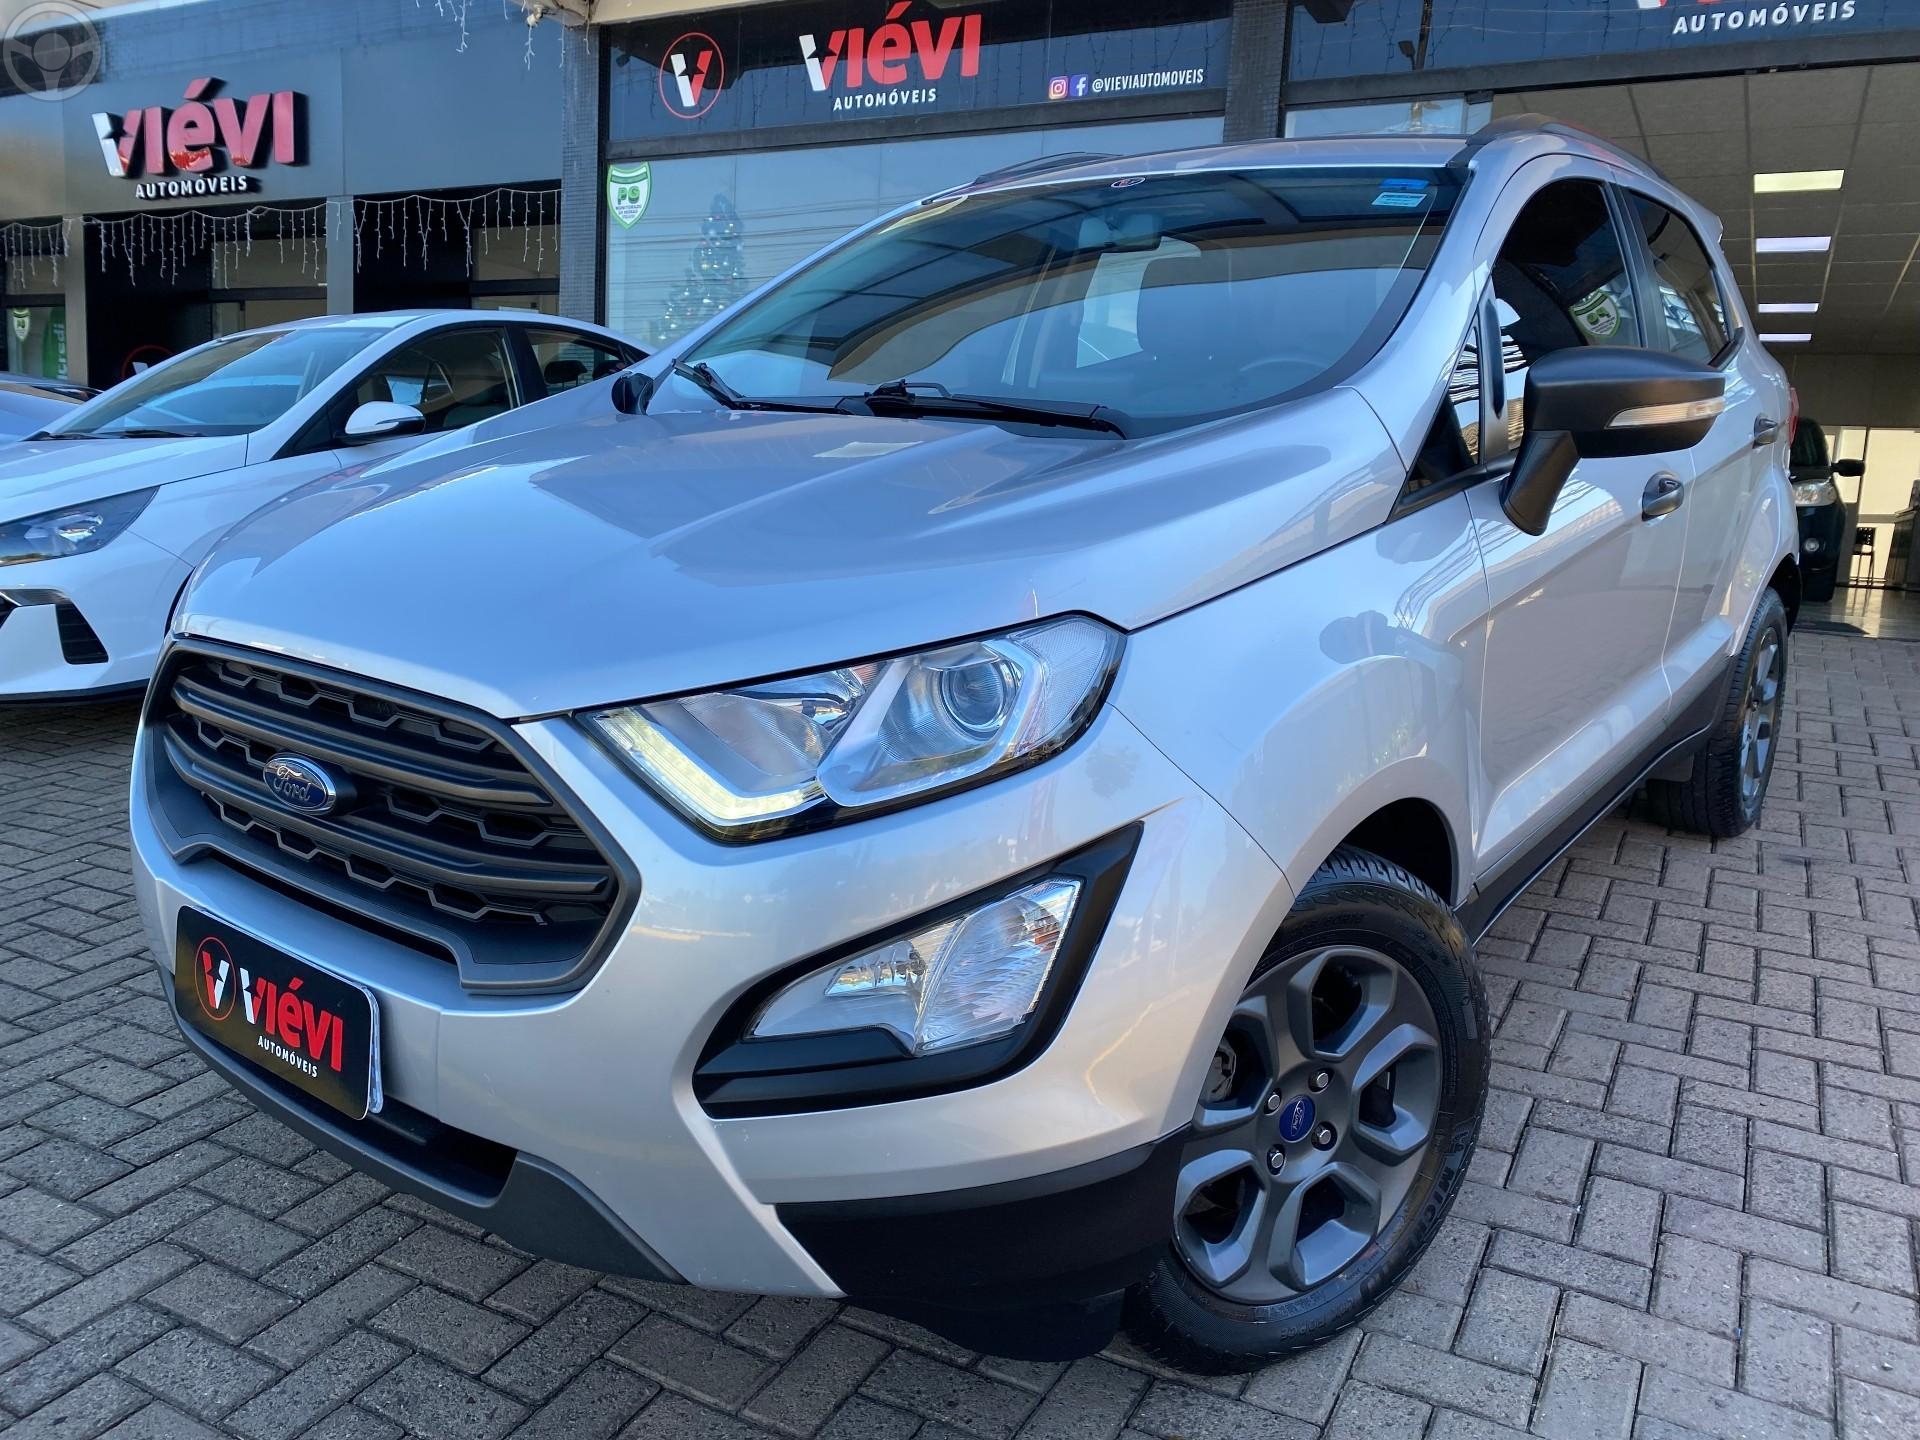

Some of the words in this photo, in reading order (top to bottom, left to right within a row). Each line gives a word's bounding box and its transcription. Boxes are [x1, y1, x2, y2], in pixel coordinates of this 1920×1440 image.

[1672, 1, 1855, 35] AUTOMÓVEIS
[1092, 69, 1204, 93] @VIEVIAUTOMOVEIS
[833, 88, 937, 112] AUTOMÓVEIS
[136, 174, 247, 198] AUTOMÓVEIS
[273, 763, 311, 801] Ford
[257, 1035, 318, 1078] AUTOMÓVEIS
